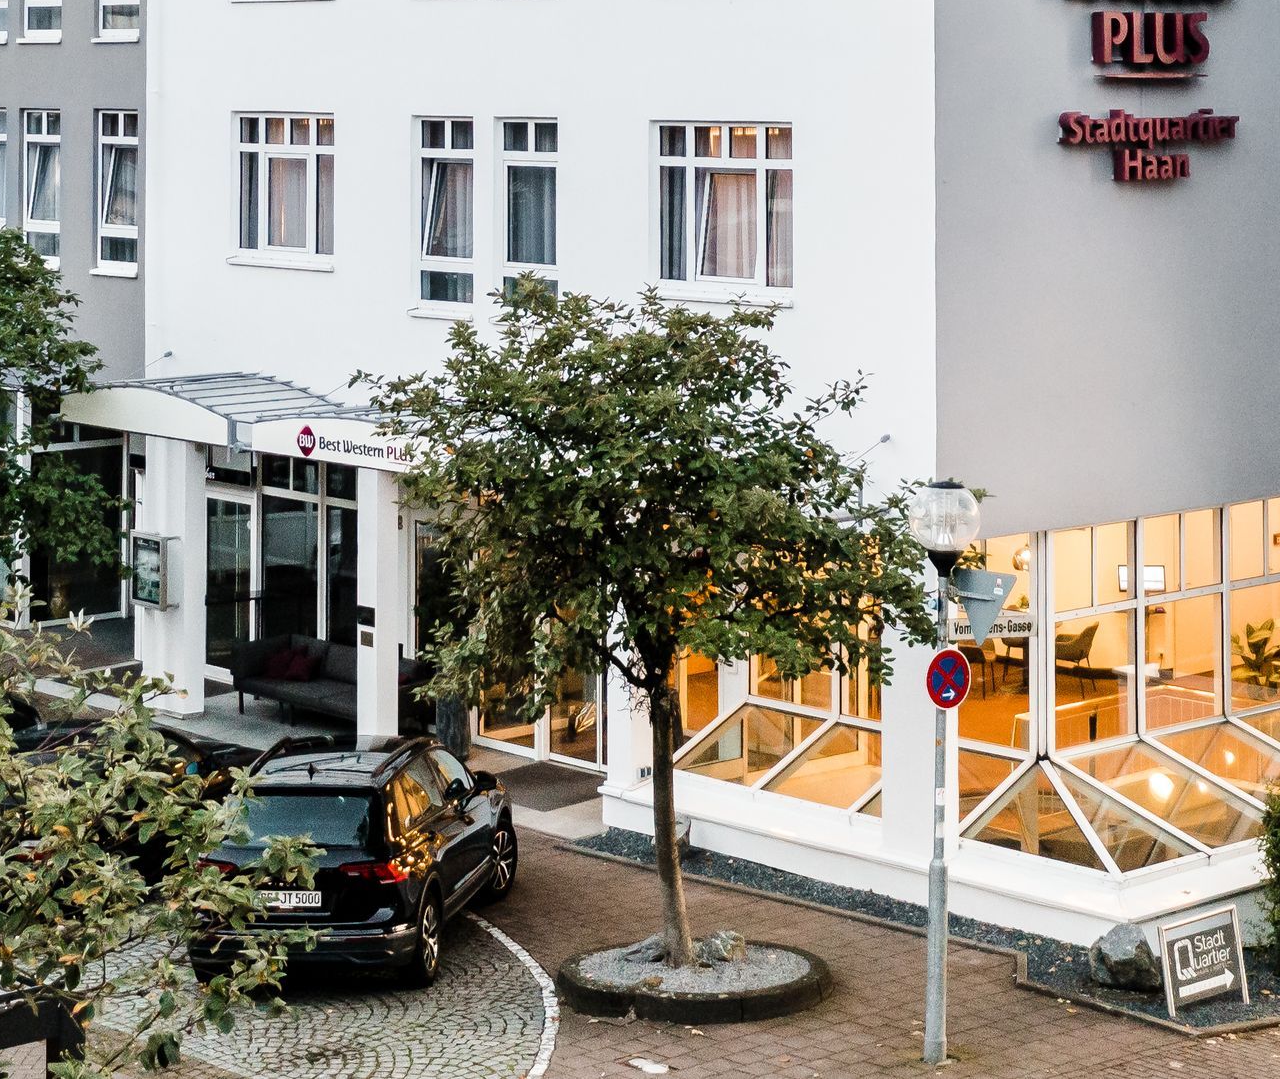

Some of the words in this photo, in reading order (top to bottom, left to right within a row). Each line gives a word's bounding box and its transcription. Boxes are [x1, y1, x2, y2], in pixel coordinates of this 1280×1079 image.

[1095, 11, 1210, 64] PLUS
[1060, 109, 1239, 149] Stadtquartier
[1117, 148, 1190, 181] Haan
[299, 433, 314, 449] BW
[319, 436, 341, 453] Best
[342, 439, 384, 459] Western
[281, 892, 293, 904] JT
[295, 892, 321, 904] 5000
[1195, 930, 1225, 951] Stadt
